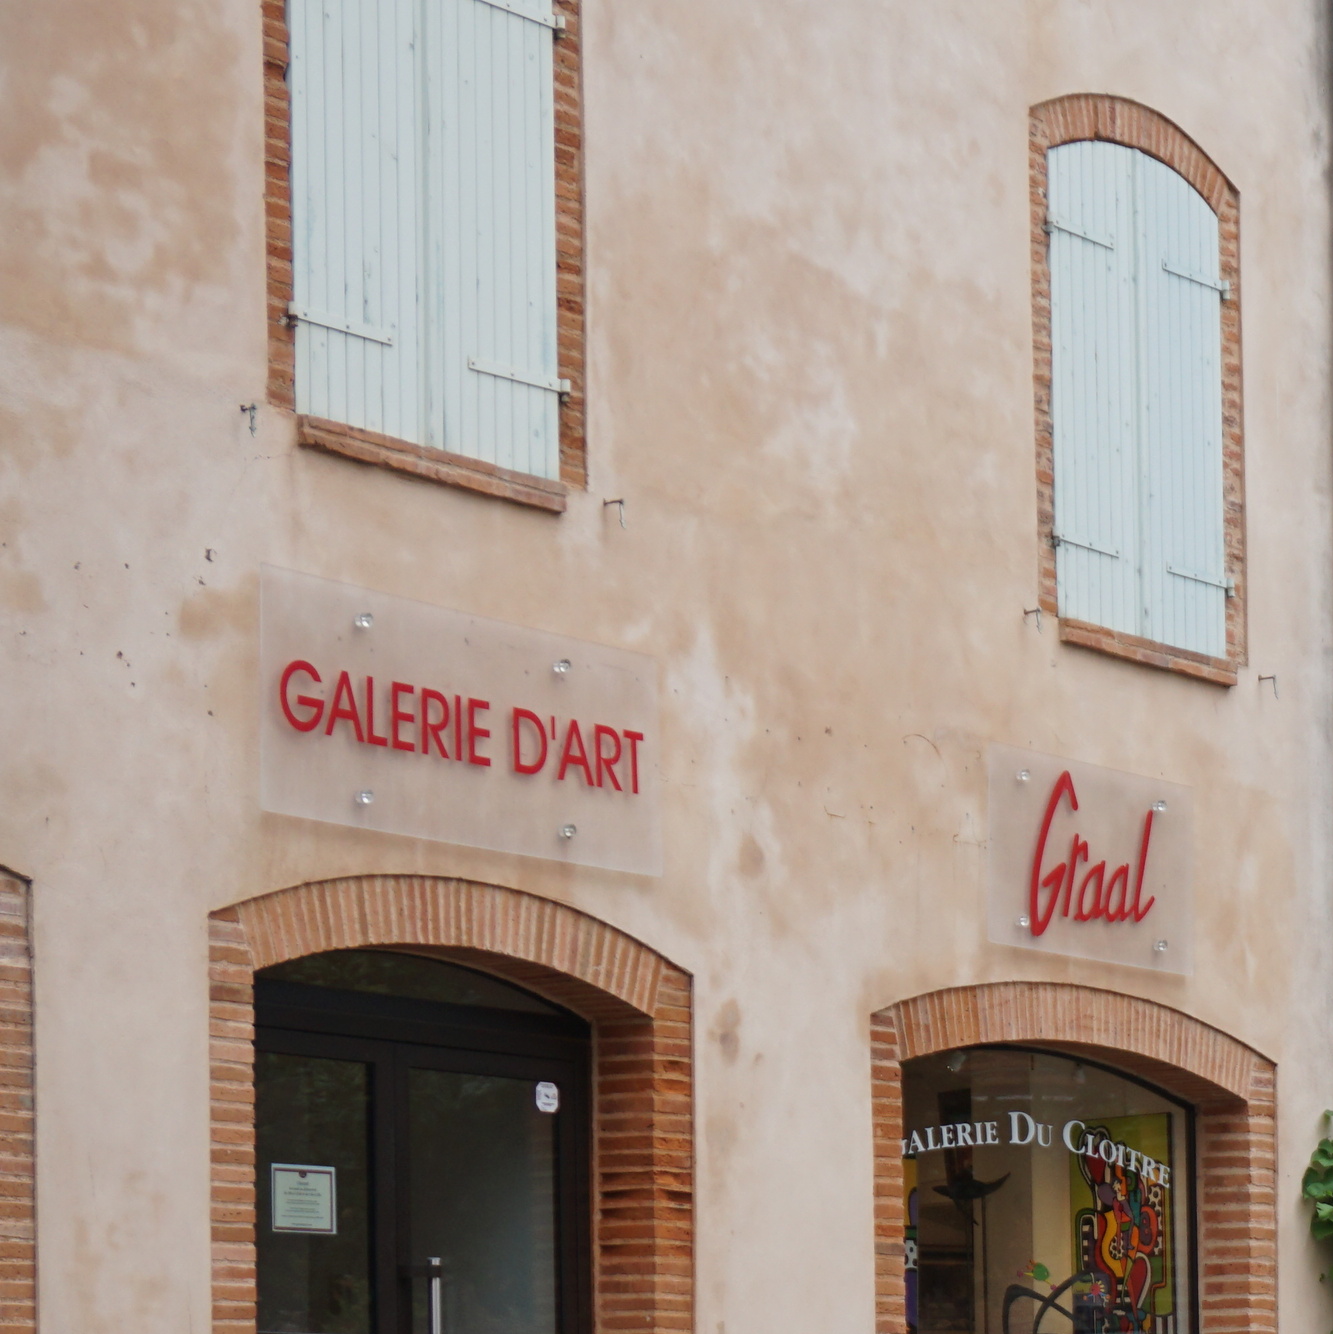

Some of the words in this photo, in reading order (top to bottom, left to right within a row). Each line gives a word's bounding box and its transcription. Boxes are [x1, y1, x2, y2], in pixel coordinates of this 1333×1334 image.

[280, 659, 493, 767] GALERIE
[512, 705, 644, 796] D'ART
[1028, 770, 1156, 938] Graal
